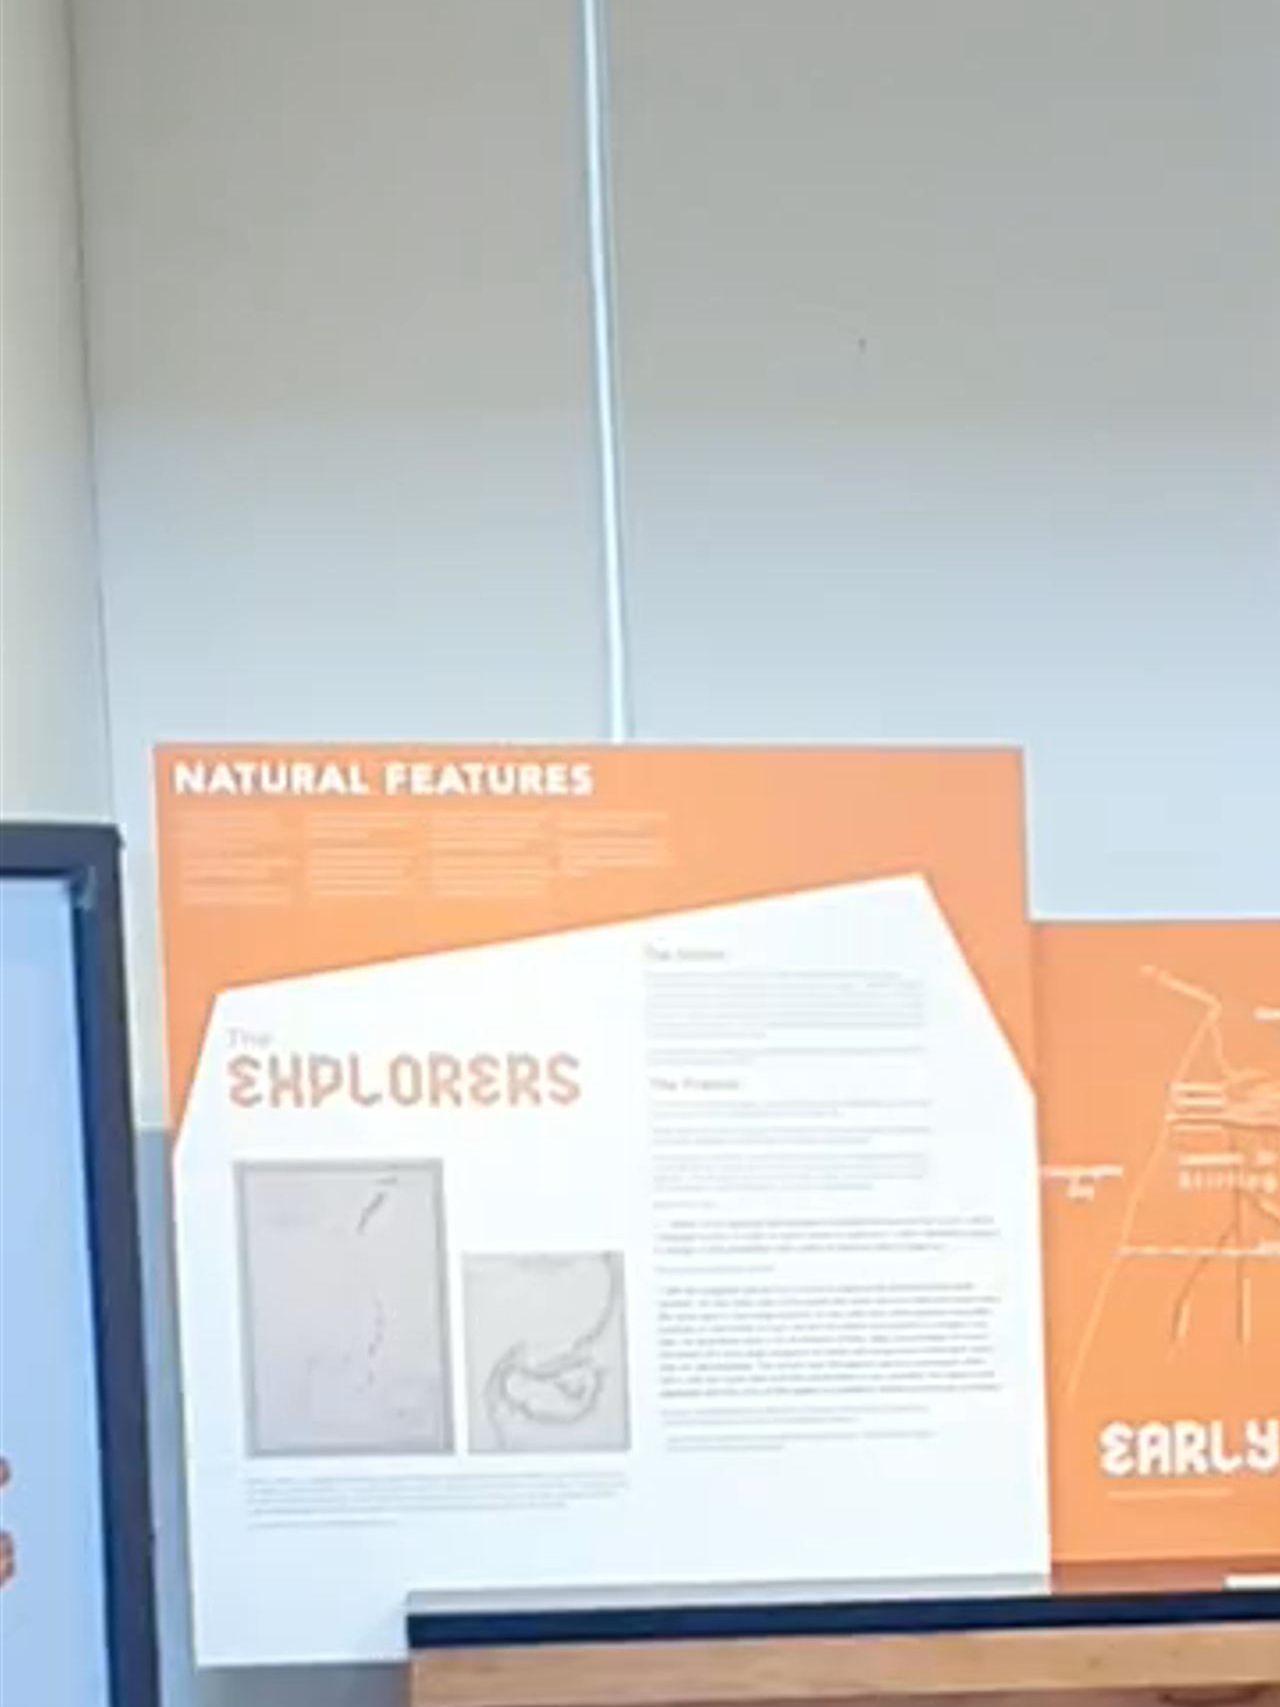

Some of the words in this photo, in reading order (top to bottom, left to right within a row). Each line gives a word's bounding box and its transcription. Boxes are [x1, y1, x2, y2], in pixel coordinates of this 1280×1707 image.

[174, 762, 369, 795] NATURAL
[384, 761, 594, 795] FEATURES
[227, 1051, 582, 1109] EXPLORERS
[1099, 1419, 1280, 1476] EARLY
